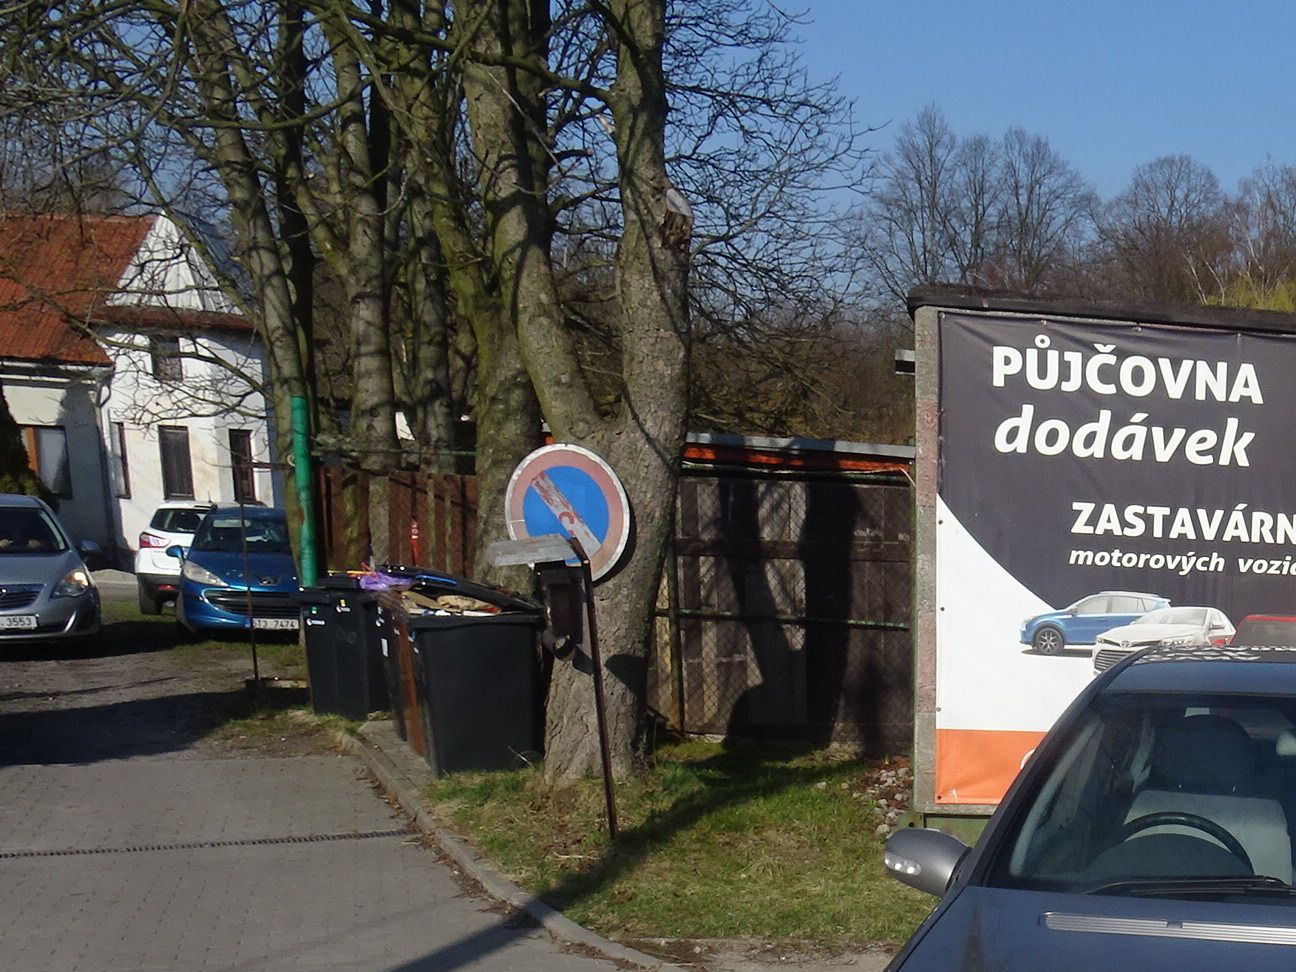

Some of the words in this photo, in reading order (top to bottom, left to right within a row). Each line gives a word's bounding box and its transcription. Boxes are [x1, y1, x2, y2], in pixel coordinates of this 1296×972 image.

[992, 335, 1264, 405] PŮJČOVNA
[994, 403, 1256, 467] dodávek
[1068, 548, 1226, 576] motorových
